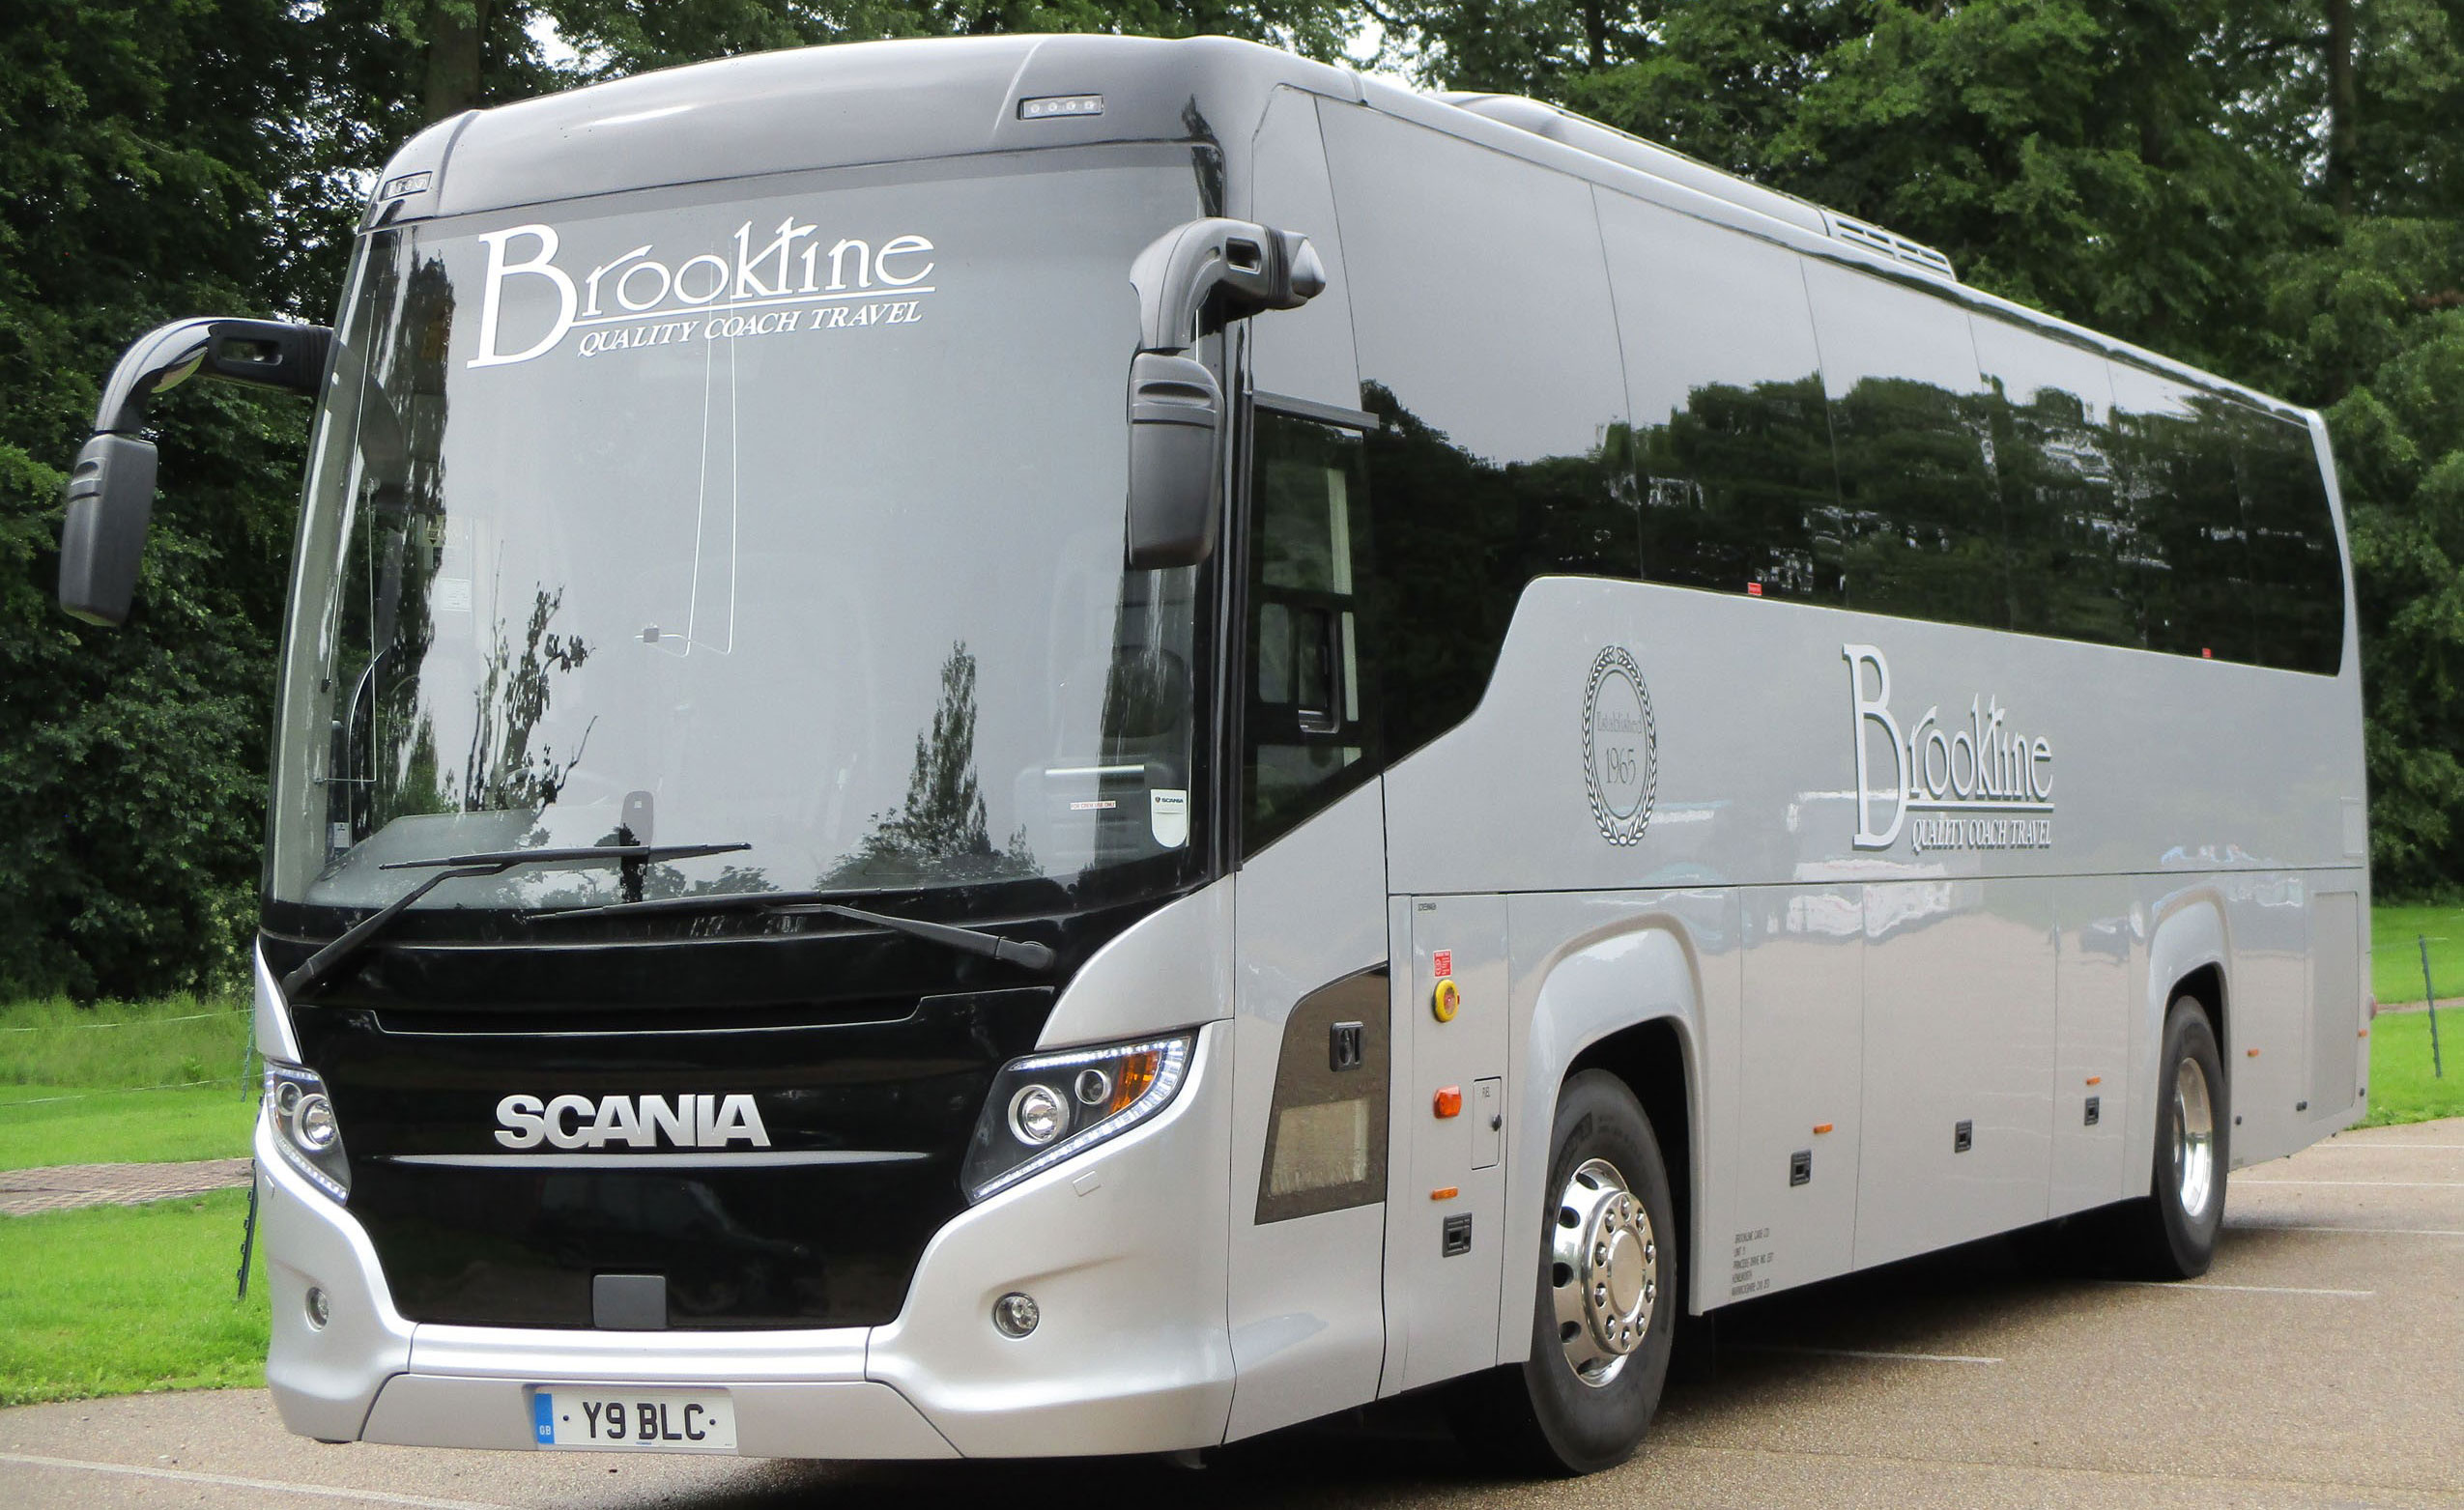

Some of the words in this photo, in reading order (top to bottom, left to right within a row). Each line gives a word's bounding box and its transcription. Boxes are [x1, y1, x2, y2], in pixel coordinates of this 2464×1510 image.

[578, 321, 699, 357] QUALITY
[703, 310, 800, 338] COACH
[810, 301, 923, 330] TRAVEL
[1606, 747, 1636, 784] 1965
[1912, 818, 1965, 855] QUALITY
[1968, 818, 2007, 848] COACH
[2010, 819, 2051, 848] TRAVEL
[494, 1095, 771, 1149] SCANIA
[539, 1425, 552, 1436] GB
[583, 1402, 626, 1439] Y9
[637, 1403, 705, 1440] BLC
